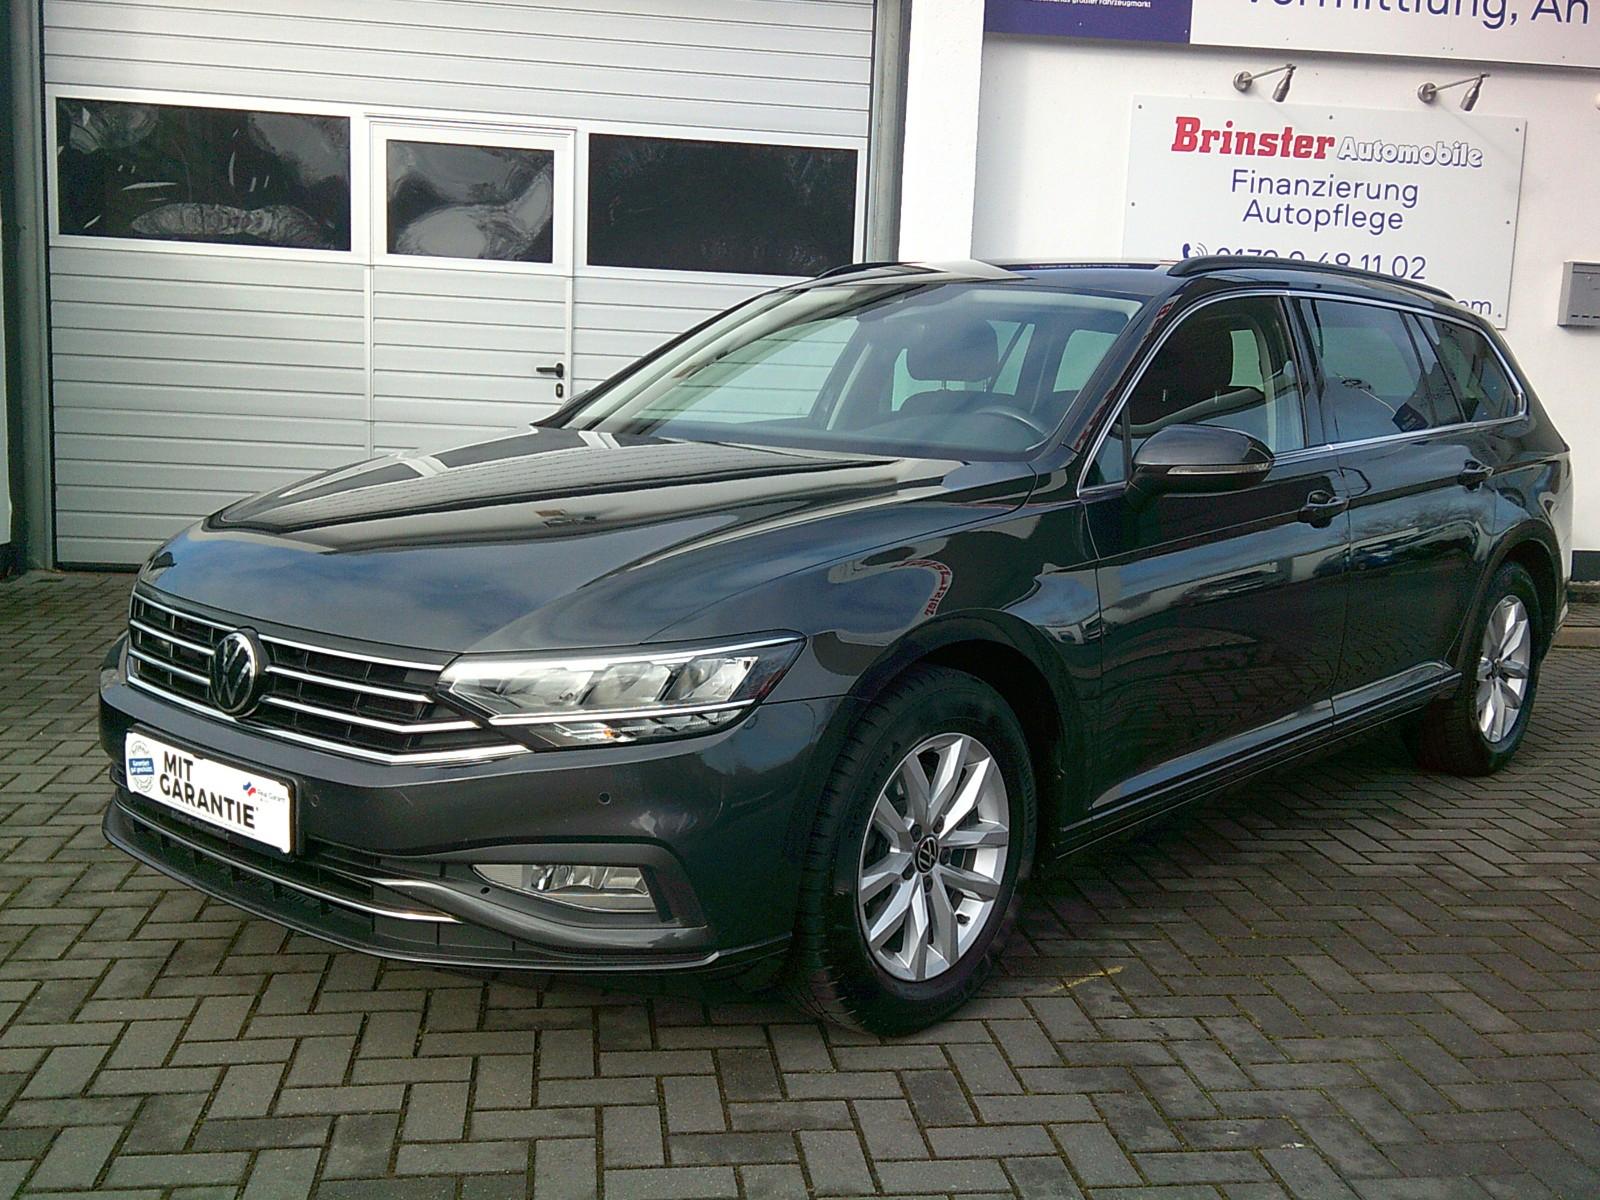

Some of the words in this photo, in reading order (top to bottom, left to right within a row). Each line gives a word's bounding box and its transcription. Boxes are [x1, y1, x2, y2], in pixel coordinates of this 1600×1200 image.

[1170, 116, 1336, 160] Brinster
[1337, 136, 1483, 168] Automobile
[1231, 169, 1419, 209] Finanzierung
[1242, 200, 1404, 236] Autopflege
[1391, 255, 1427, 280] 02
[163, 751, 194, 782] MIT
[159, 773, 256, 830] GARANTIE
